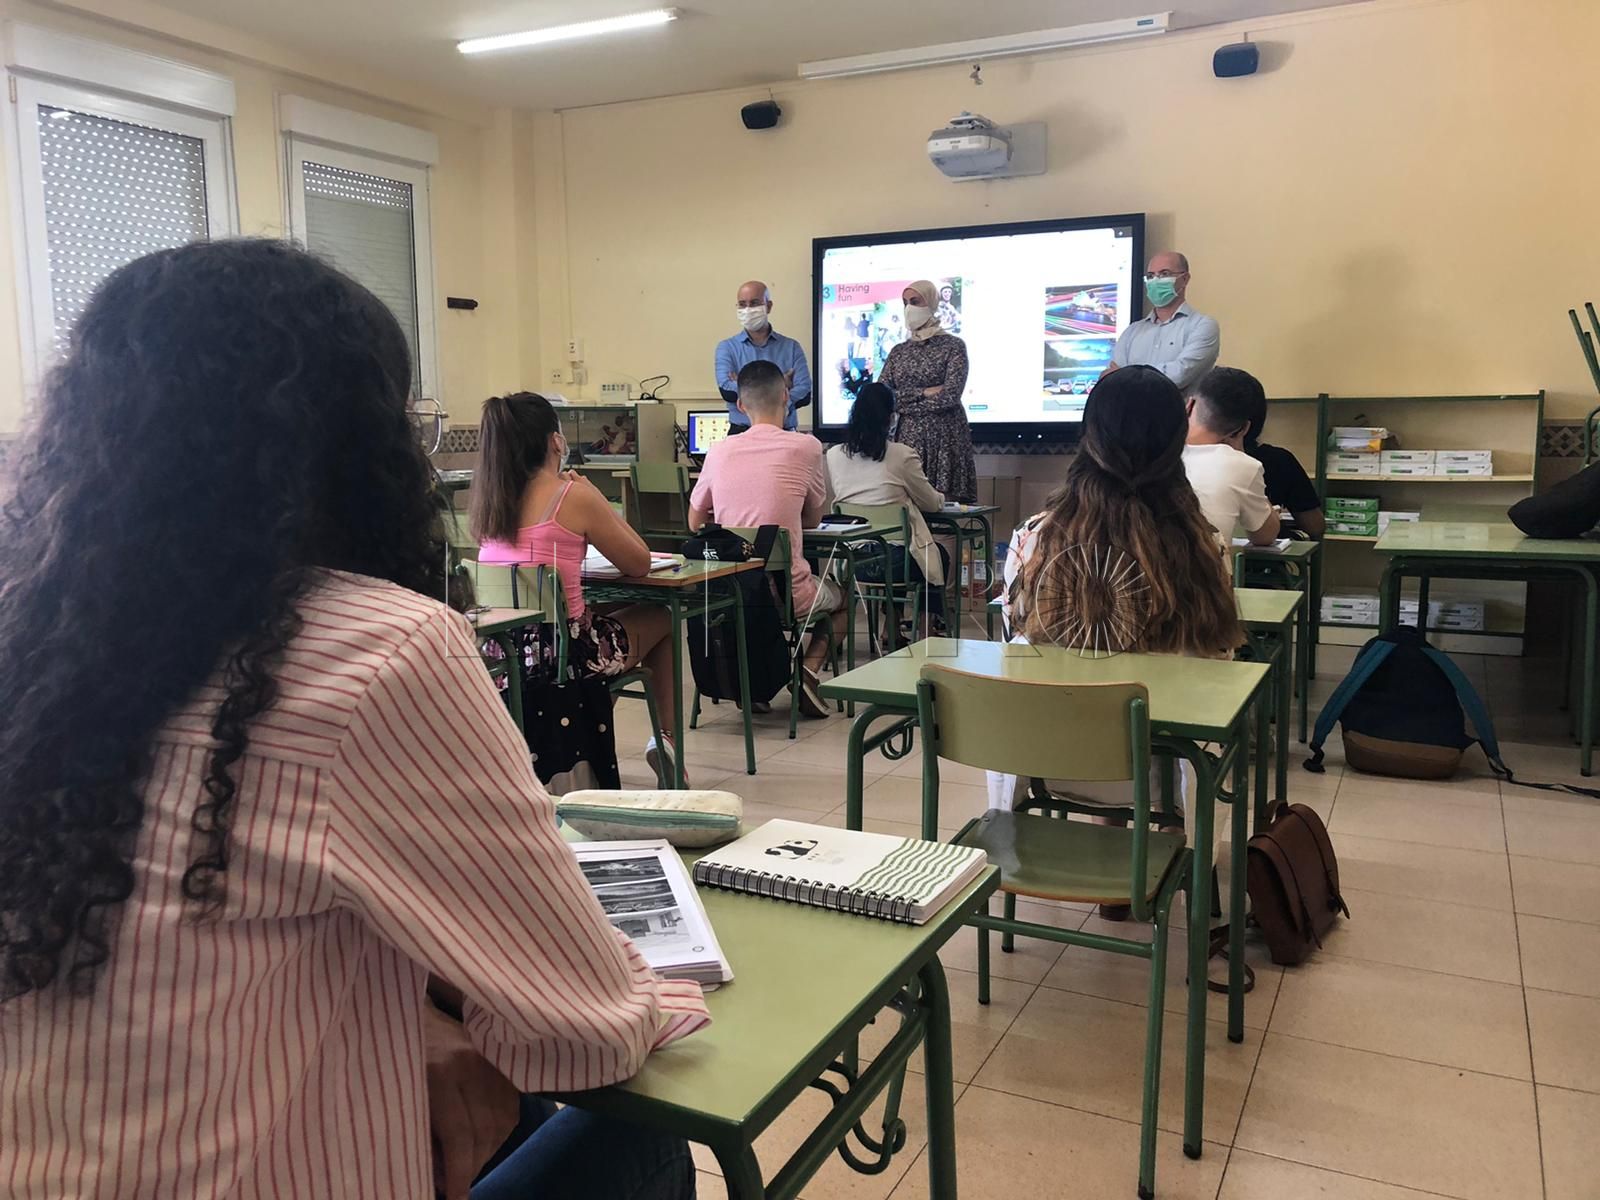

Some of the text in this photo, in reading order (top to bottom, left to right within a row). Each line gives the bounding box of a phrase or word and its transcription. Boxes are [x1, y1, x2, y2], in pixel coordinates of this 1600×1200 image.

[823, 283, 870, 300] 3 Having
[838, 294, 853, 302] fun
